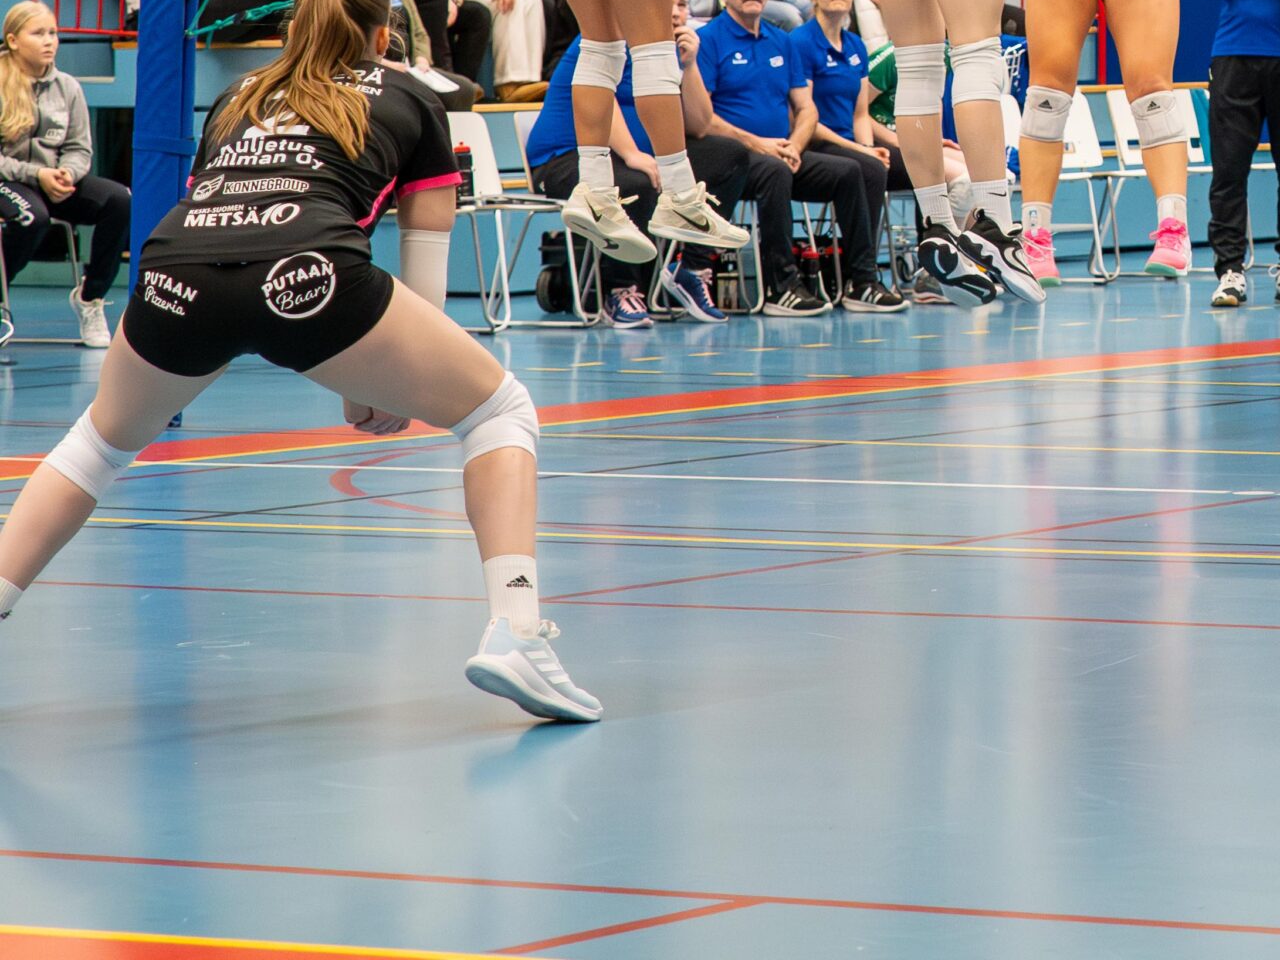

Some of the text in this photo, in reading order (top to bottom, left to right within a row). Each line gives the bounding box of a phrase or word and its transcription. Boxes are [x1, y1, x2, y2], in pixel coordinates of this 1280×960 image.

[295, 152, 324, 170] Oy
[223, 177, 310, 195] KONNEGROUP
[188, 203, 245, 215] KESKI-SUOMEN
[143, 270, 198, 303] PUTAAN
[261, 261, 335, 299] PUTAAN
[275, 279, 329, 312] Baari
[143, 285, 186, 317] Pizzeria
